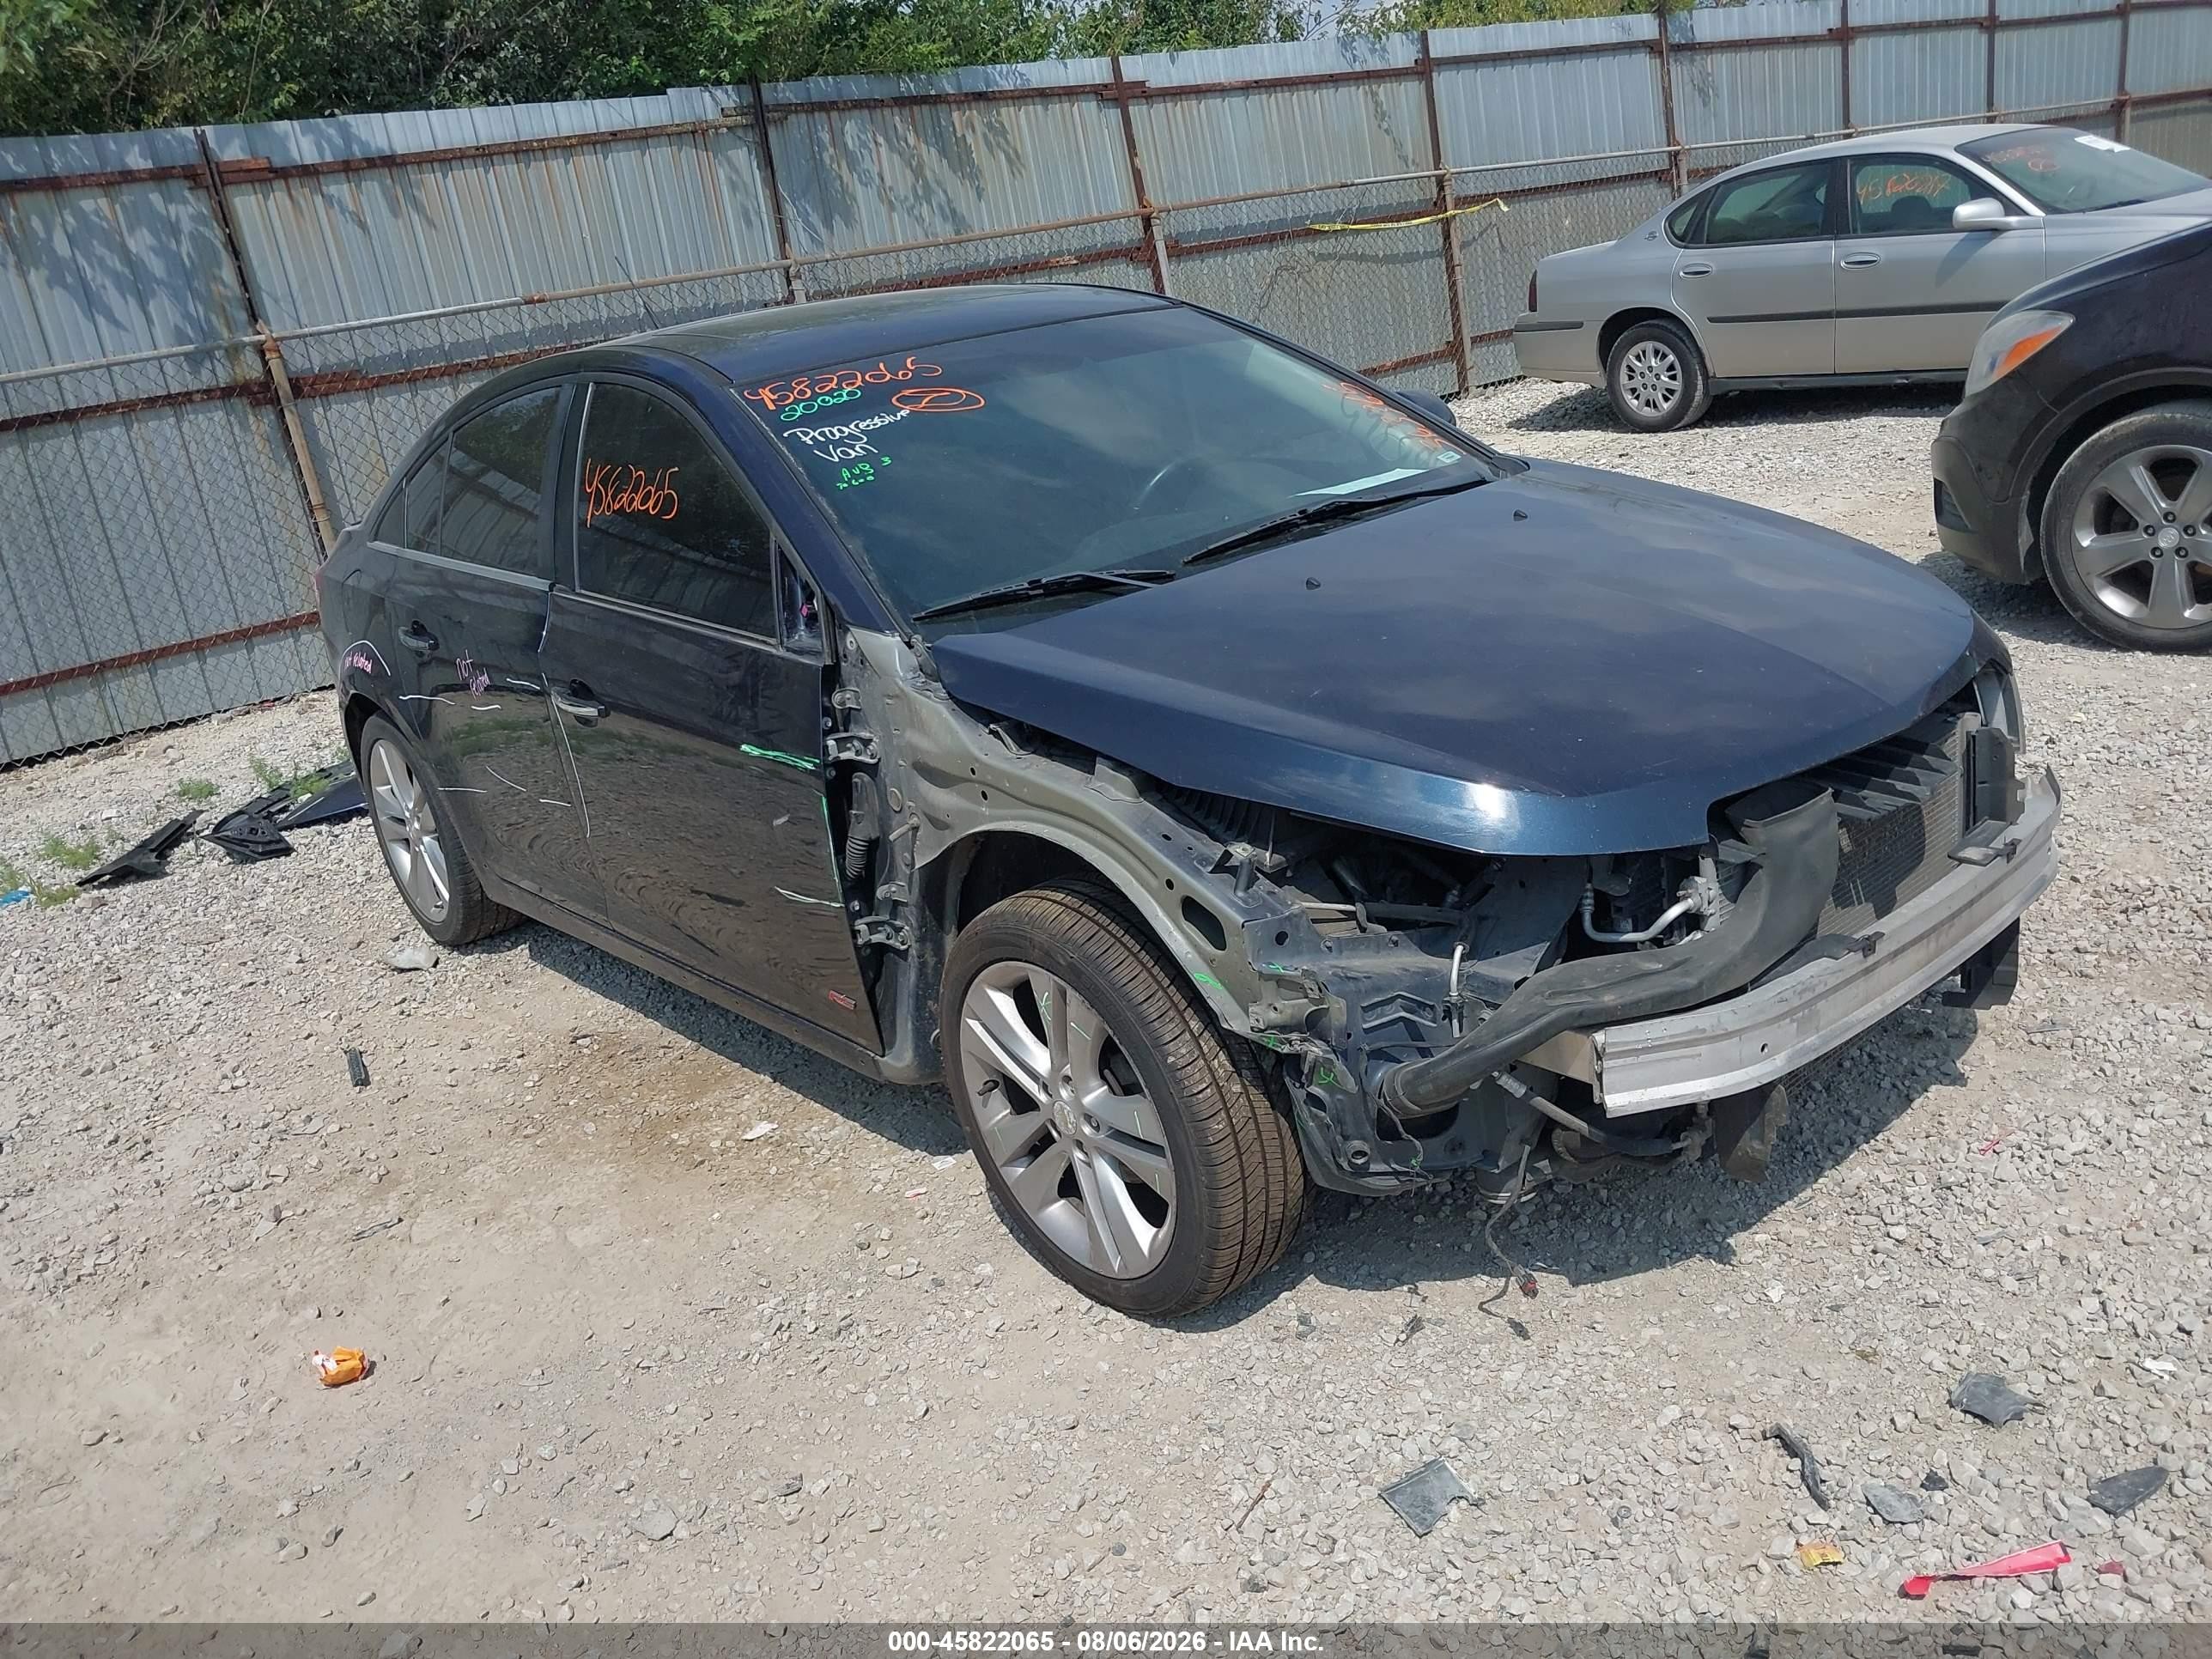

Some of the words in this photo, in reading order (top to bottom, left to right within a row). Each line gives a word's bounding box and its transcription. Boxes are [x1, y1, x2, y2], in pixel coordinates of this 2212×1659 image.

[744, 357, 943, 410] 45822065
[782, 409, 910, 445] Progressive
[586, 458, 679, 528] 45822065
